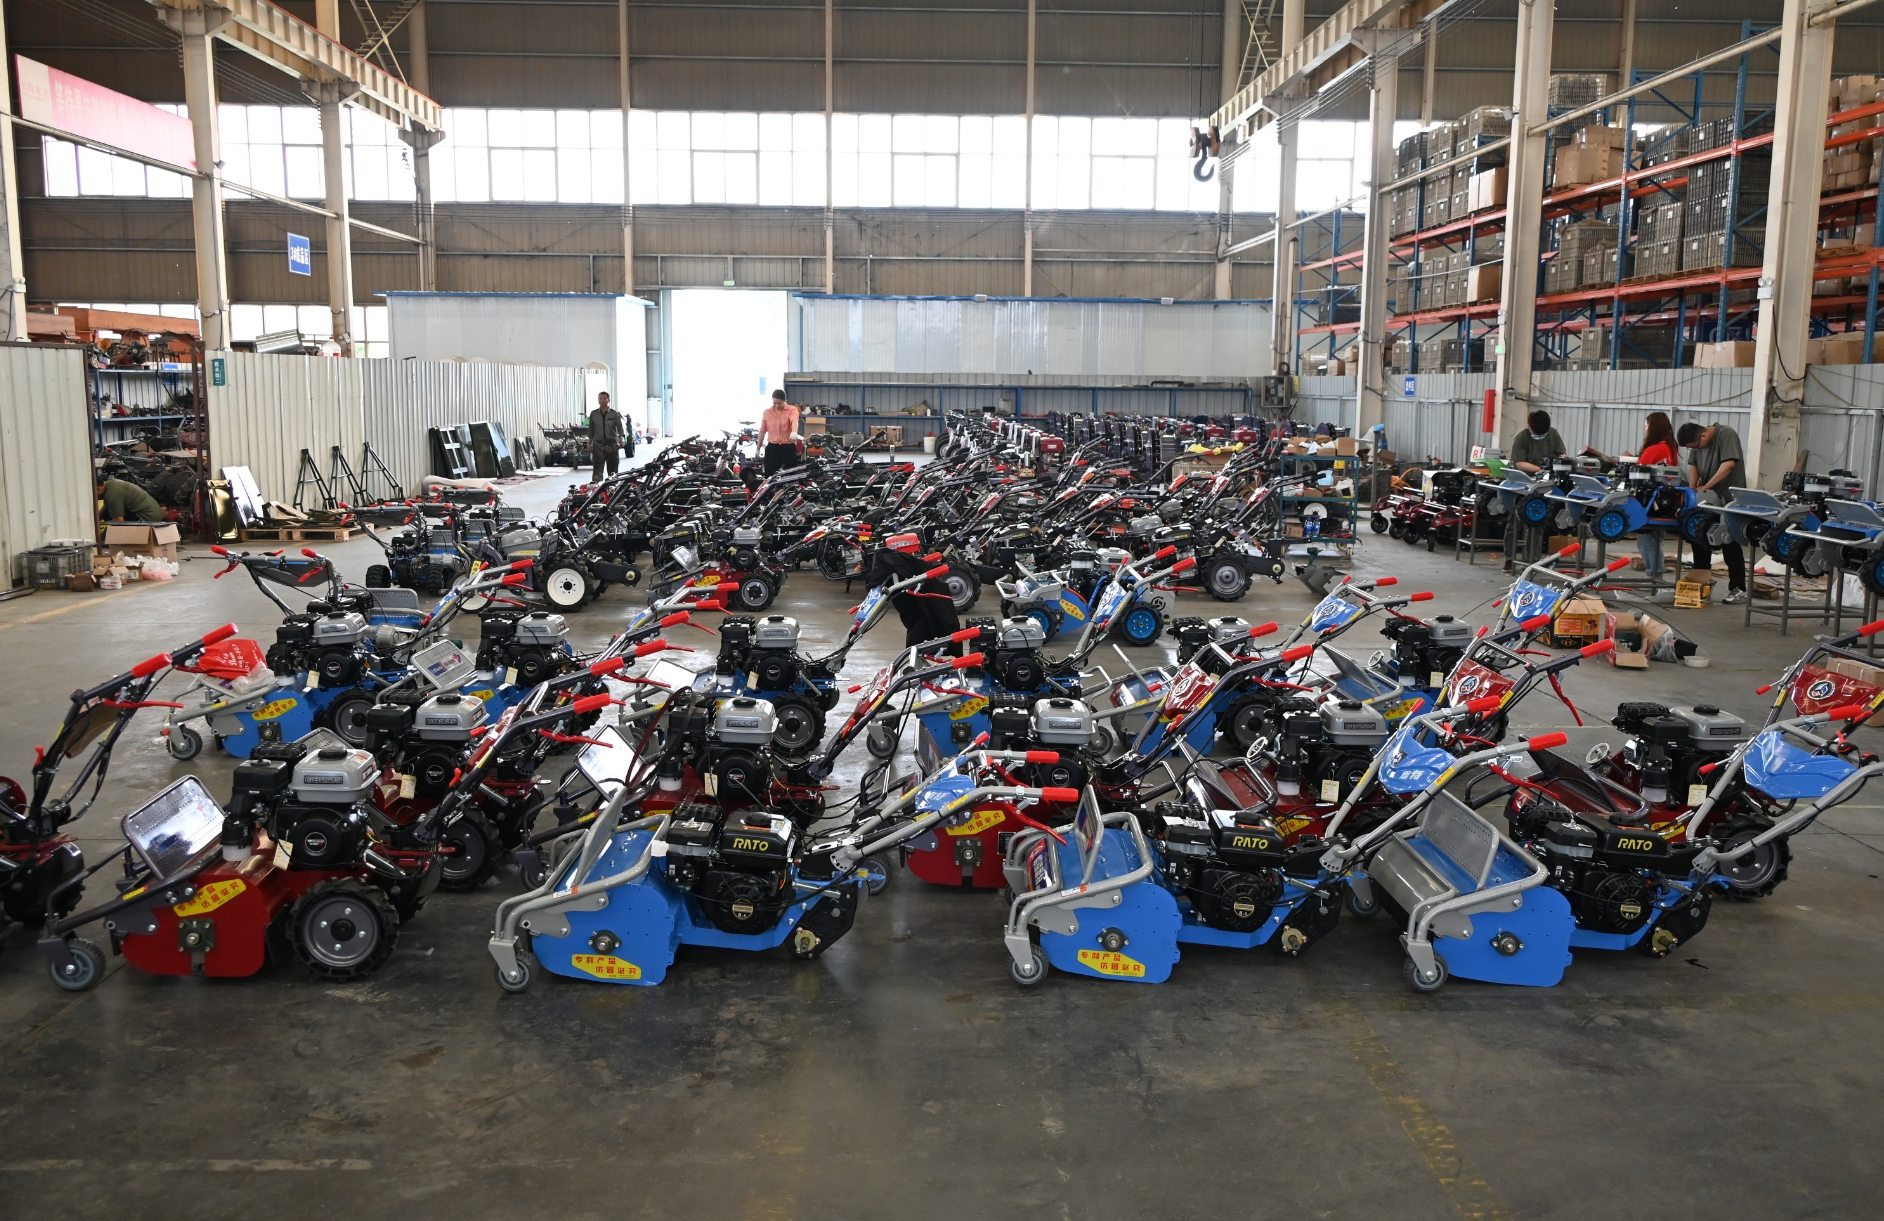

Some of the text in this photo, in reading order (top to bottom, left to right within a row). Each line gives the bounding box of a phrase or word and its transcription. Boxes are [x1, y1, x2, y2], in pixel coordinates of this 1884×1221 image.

[733, 837, 769, 852] RATO
[1232, 835, 1269, 850] RATO
[1617, 838, 1653, 851] RATO
[575, 955, 616, 965] 专利产品
[1081, 951, 1122, 962] 专利产品
[595, 965, 637, 975] 仿冒必究
[1100, 961, 1141, 972] 仿冒必究
